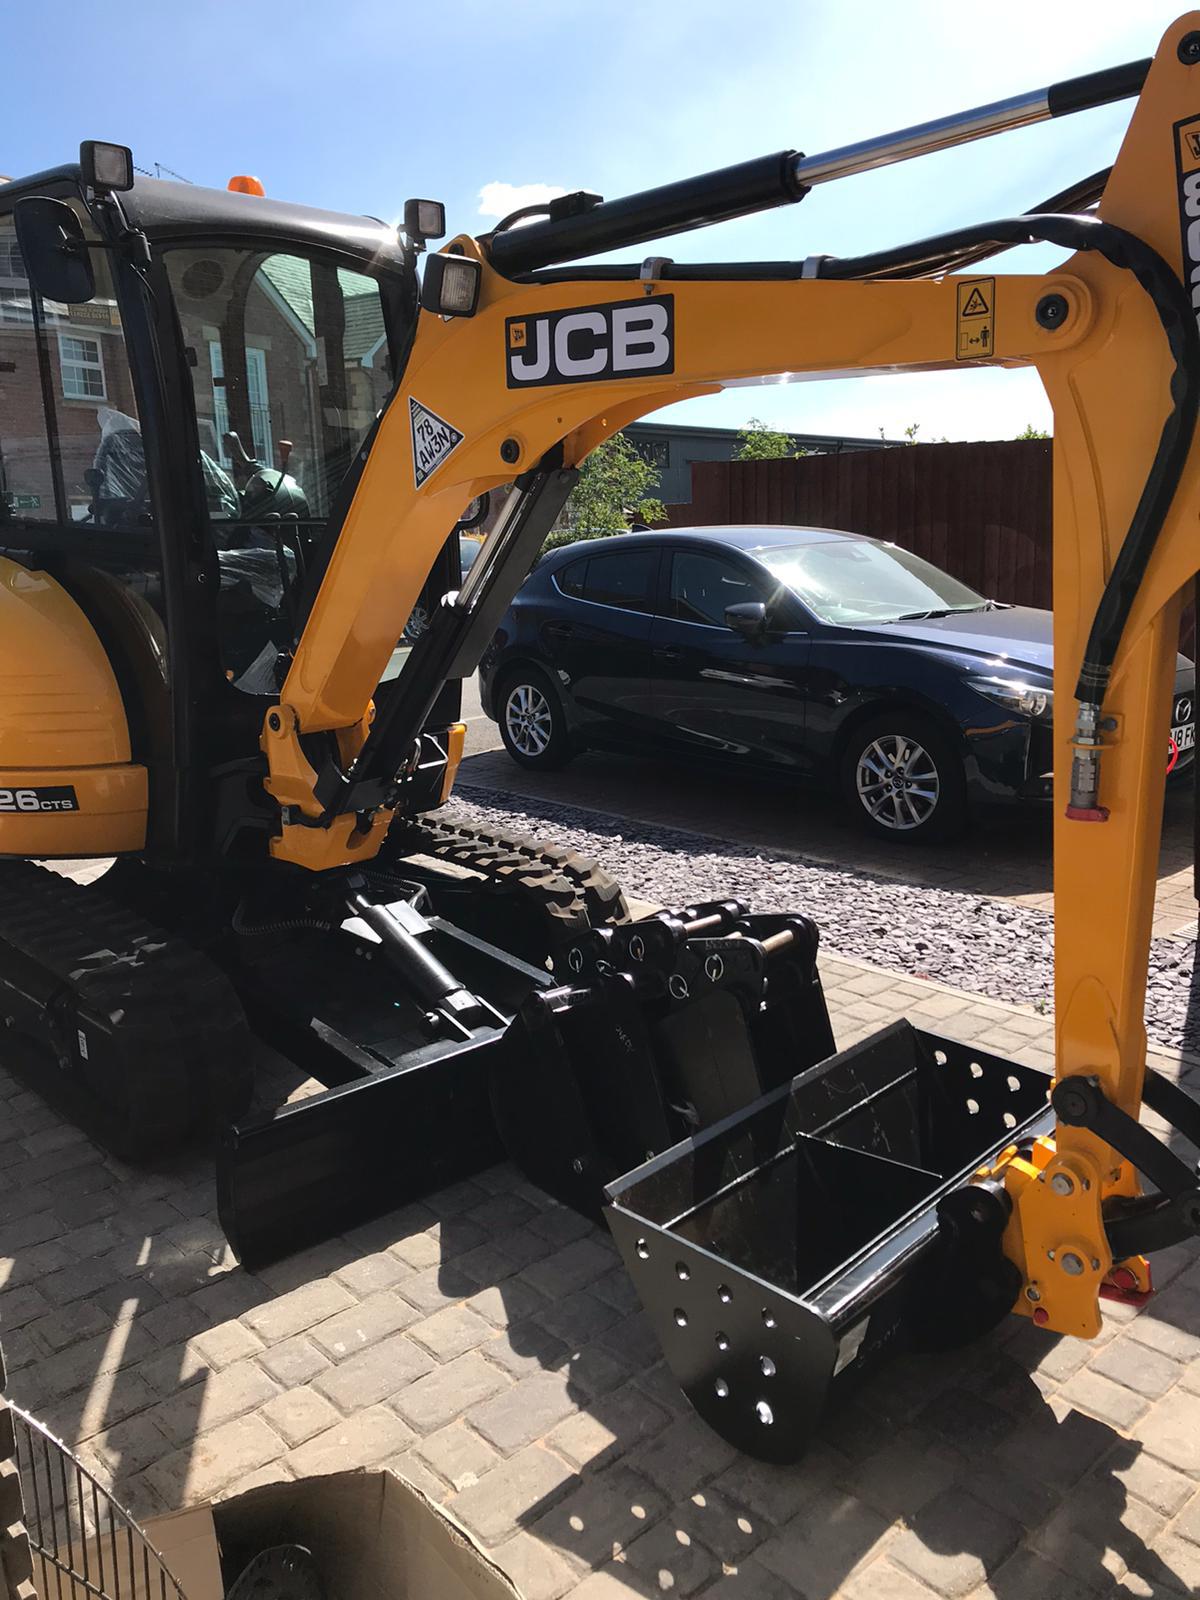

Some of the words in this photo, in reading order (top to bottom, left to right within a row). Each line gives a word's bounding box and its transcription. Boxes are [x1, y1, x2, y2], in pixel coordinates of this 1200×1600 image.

[510, 303, 670, 381] JCB
[417, 418, 434, 443] 78
[419, 427, 450, 467] AW3N
